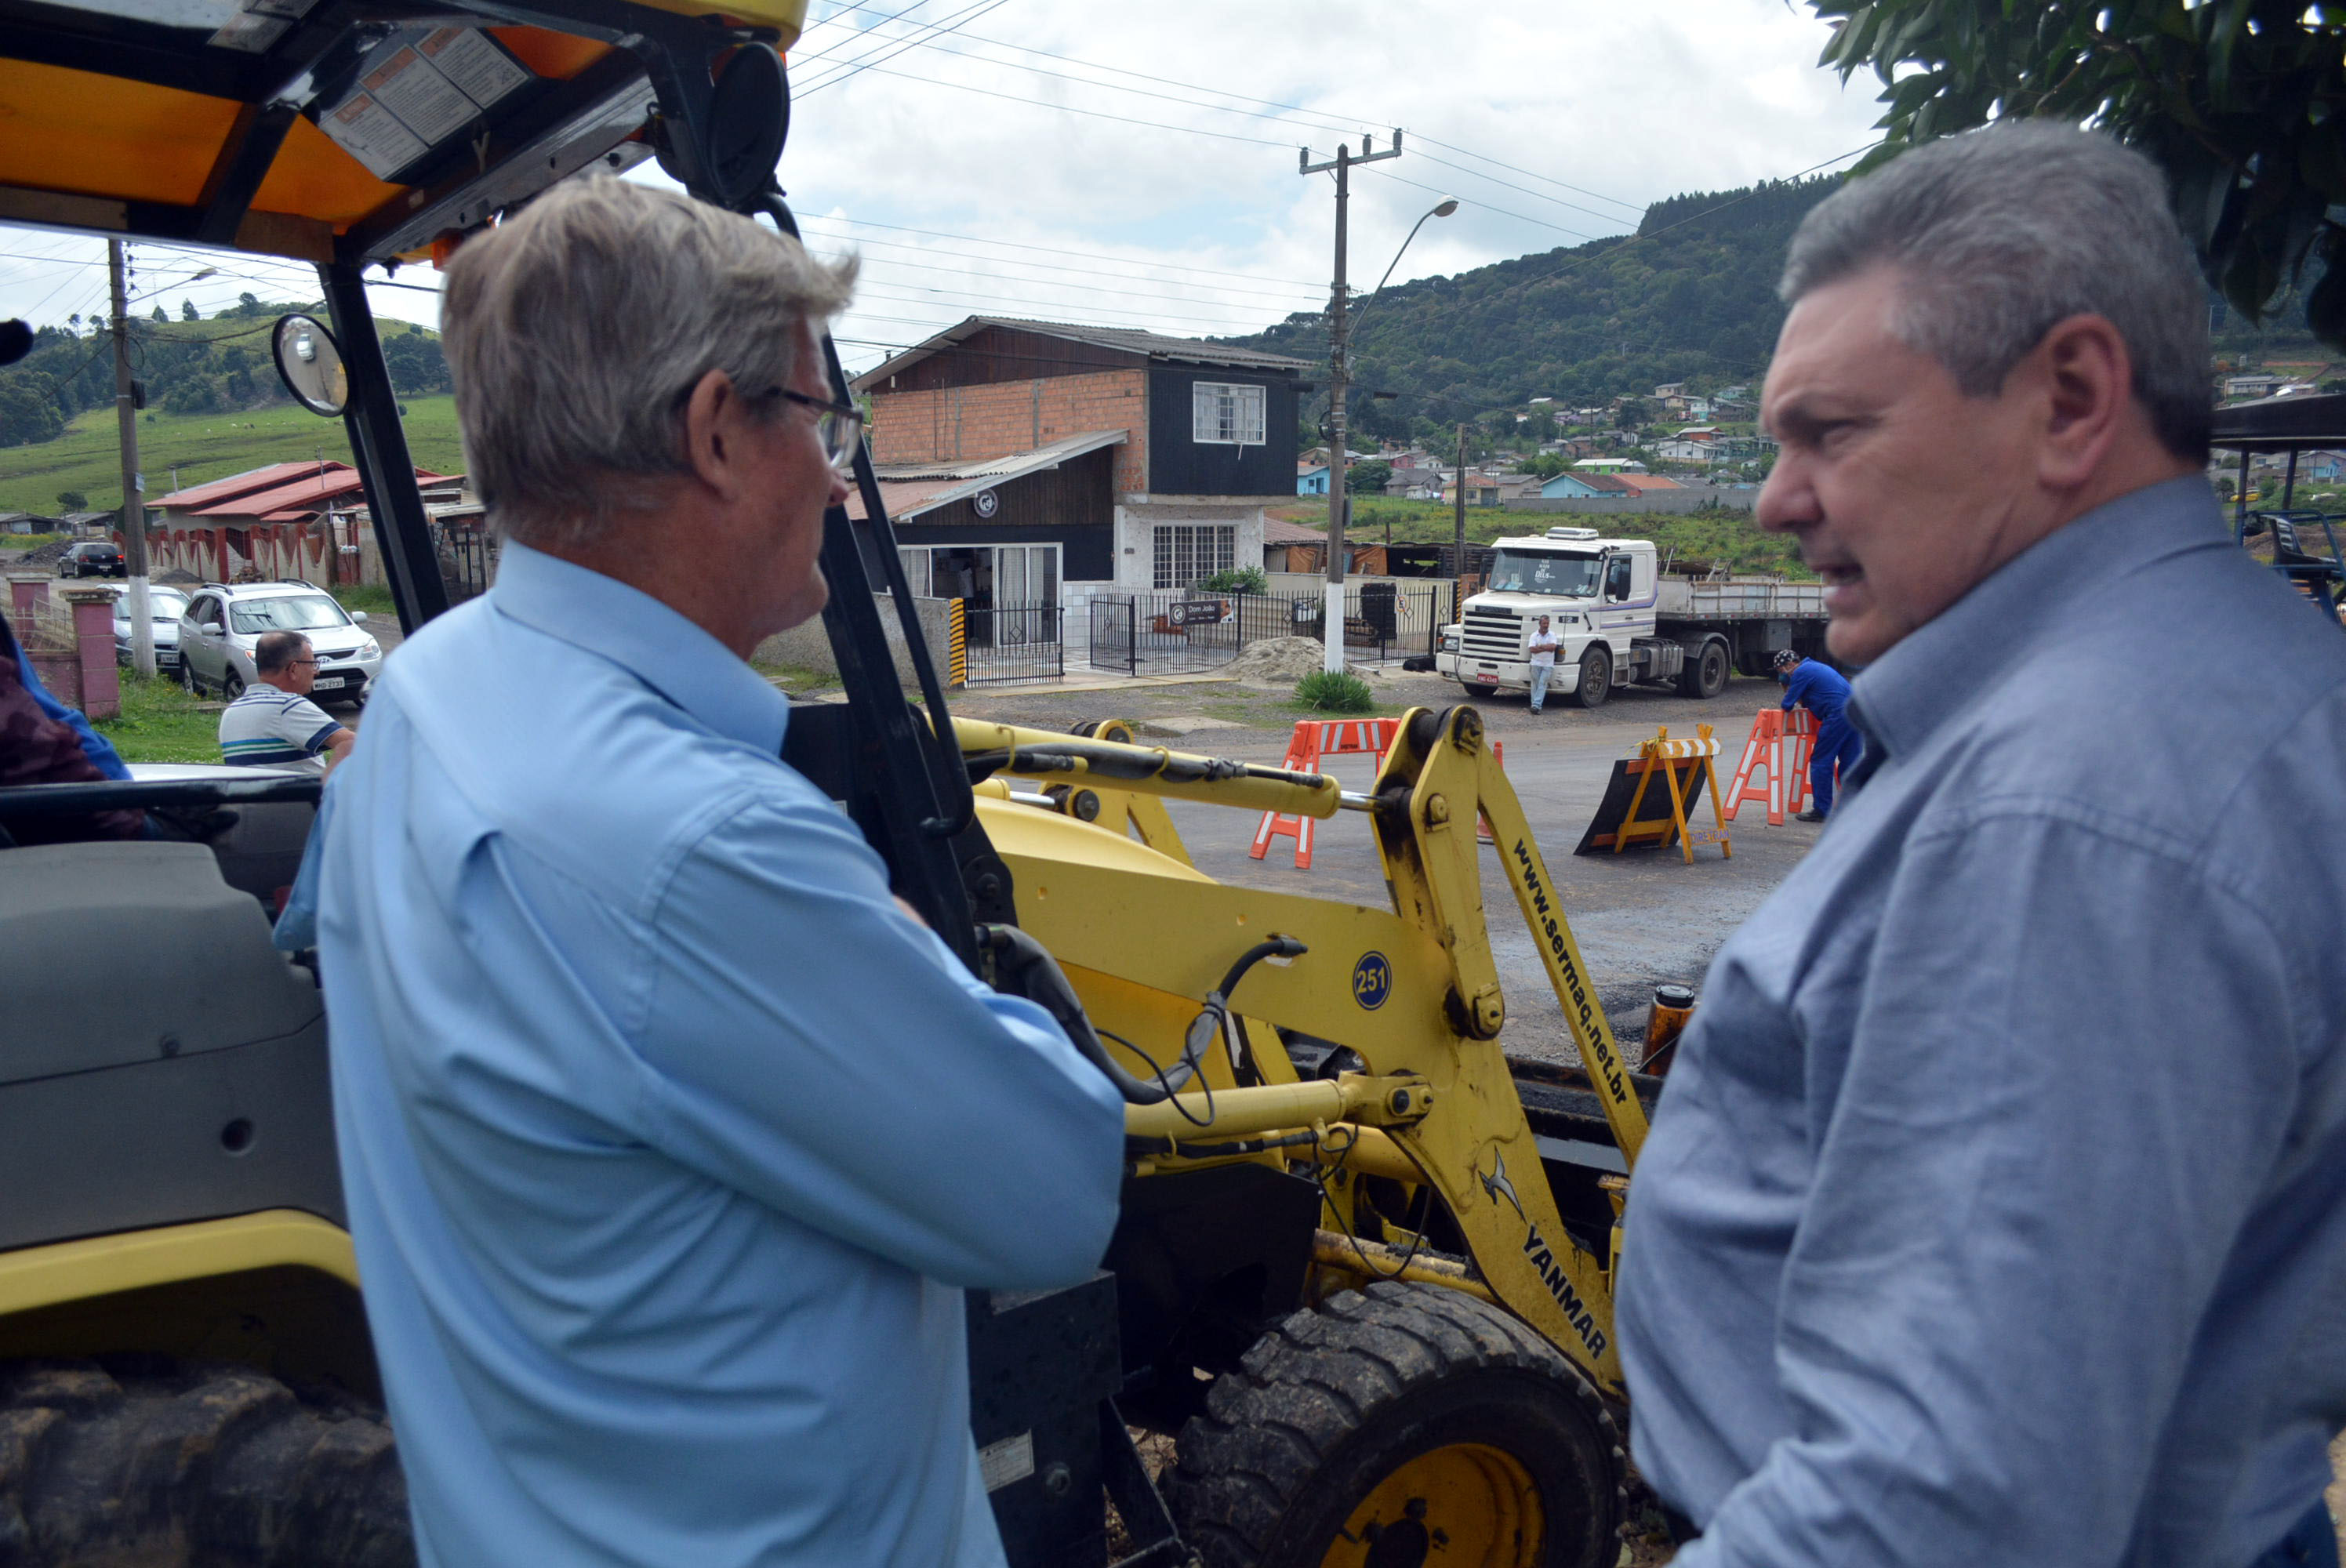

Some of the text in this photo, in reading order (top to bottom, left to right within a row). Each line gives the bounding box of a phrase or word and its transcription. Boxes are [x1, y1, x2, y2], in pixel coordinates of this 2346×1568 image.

[1203, 604, 1215, 612] João
[1690, 829, 1730, 843] DIRETRAN
[1357, 966, 1385, 994] 251
[1513, 838, 1627, 1105] www.sermaq.net.br
[1523, 1224, 1607, 1361] YANMAR
